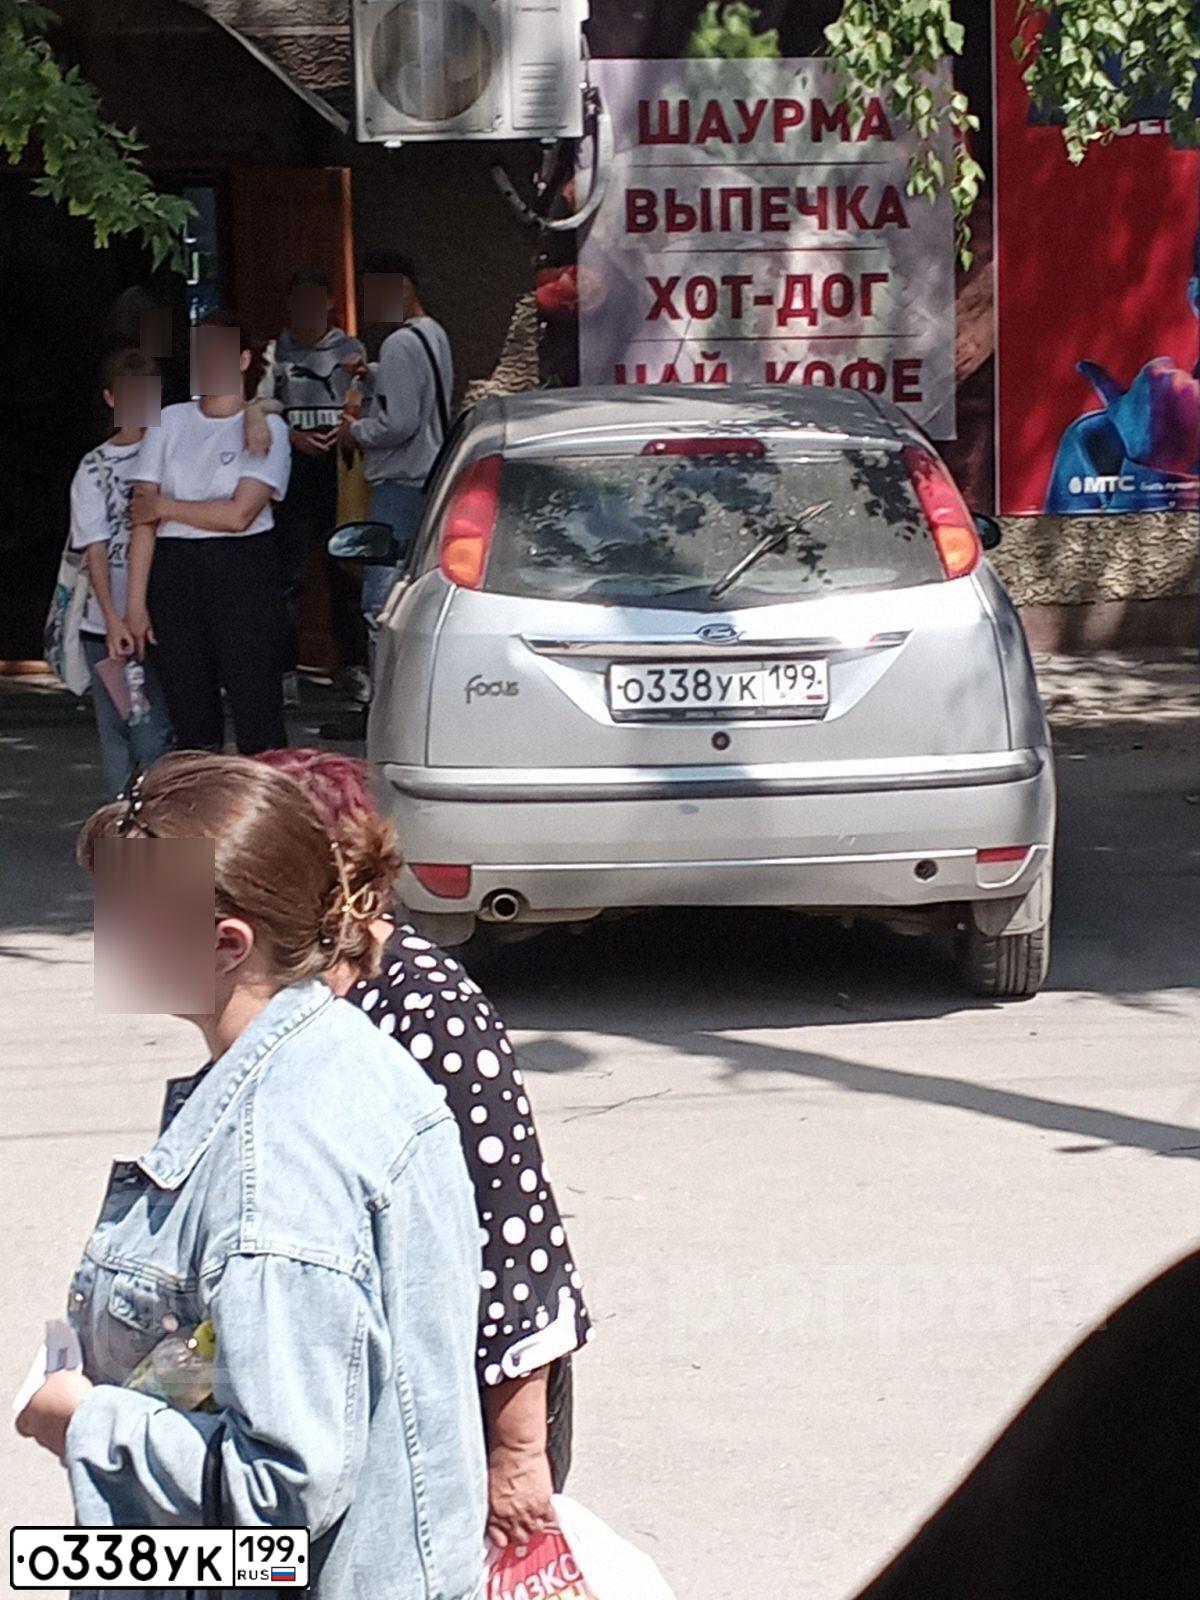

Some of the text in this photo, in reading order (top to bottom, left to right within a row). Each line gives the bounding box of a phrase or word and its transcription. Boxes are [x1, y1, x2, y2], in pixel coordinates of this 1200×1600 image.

[638, 98, 894, 145] ШАУРМА
[625, 186, 910, 233] ВЫПЕЧКА
[645, 273, 889, 326] ХОТ-ДОГ
[765, 357, 923, 403] КОФЕ
[1083, 476, 1135, 493] МТС
[769, 664, 816, 691] 199
